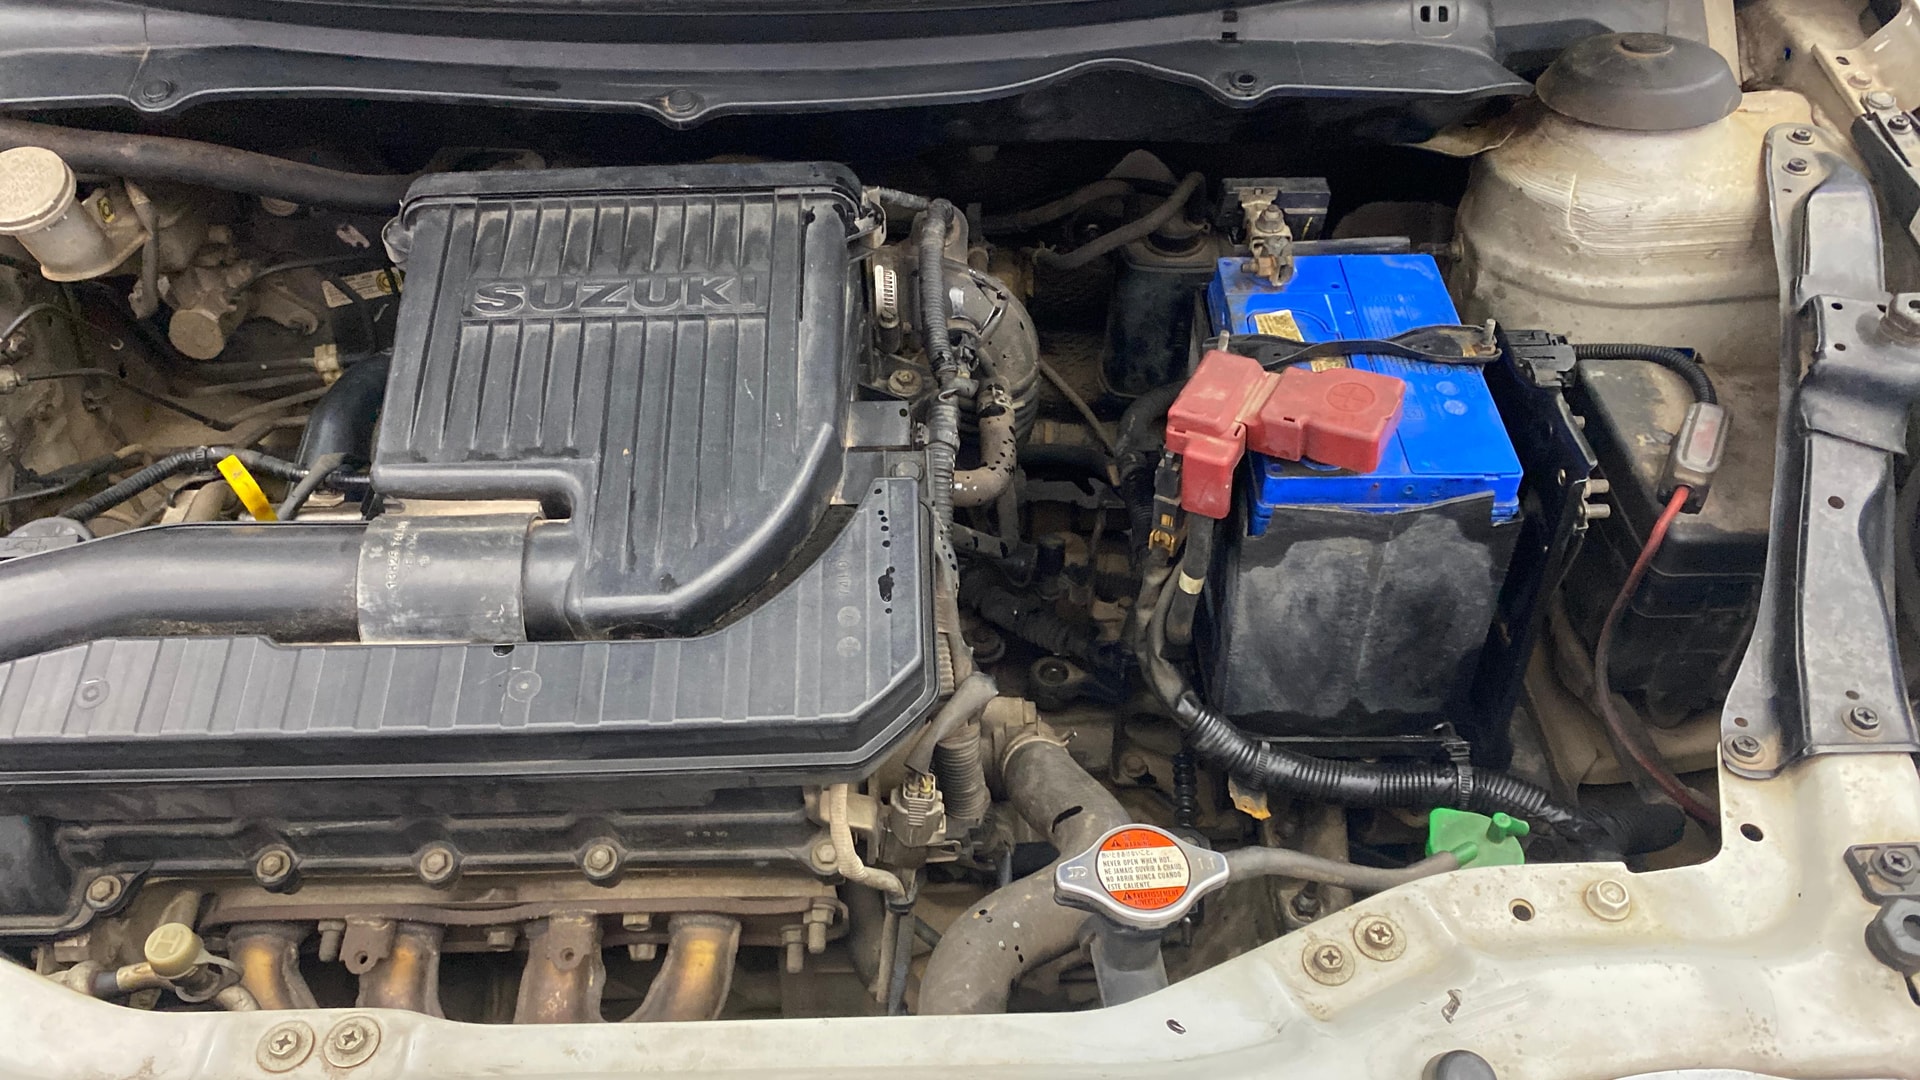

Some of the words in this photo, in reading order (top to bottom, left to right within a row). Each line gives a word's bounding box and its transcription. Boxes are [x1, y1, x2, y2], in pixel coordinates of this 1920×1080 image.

[472, 276, 757, 316] SUZUKI
[1103, 859, 1122, 868] NEVER
[1123, 858, 1139, 867] OPEN
[1141, 857, 1158, 866] WHEN
[1114, 866, 1134, 875] JAMAIS
[1135, 865, 1156, 873] OUVRIR
[1105, 875, 1114, 883] NO
[1116, 874, 1134, 882] ABRIR
[1136, 872, 1156, 880] NUNCA
[1158, 871, 1182, 879] CUANDO
[1107, 882, 1121, 890] ESTE
